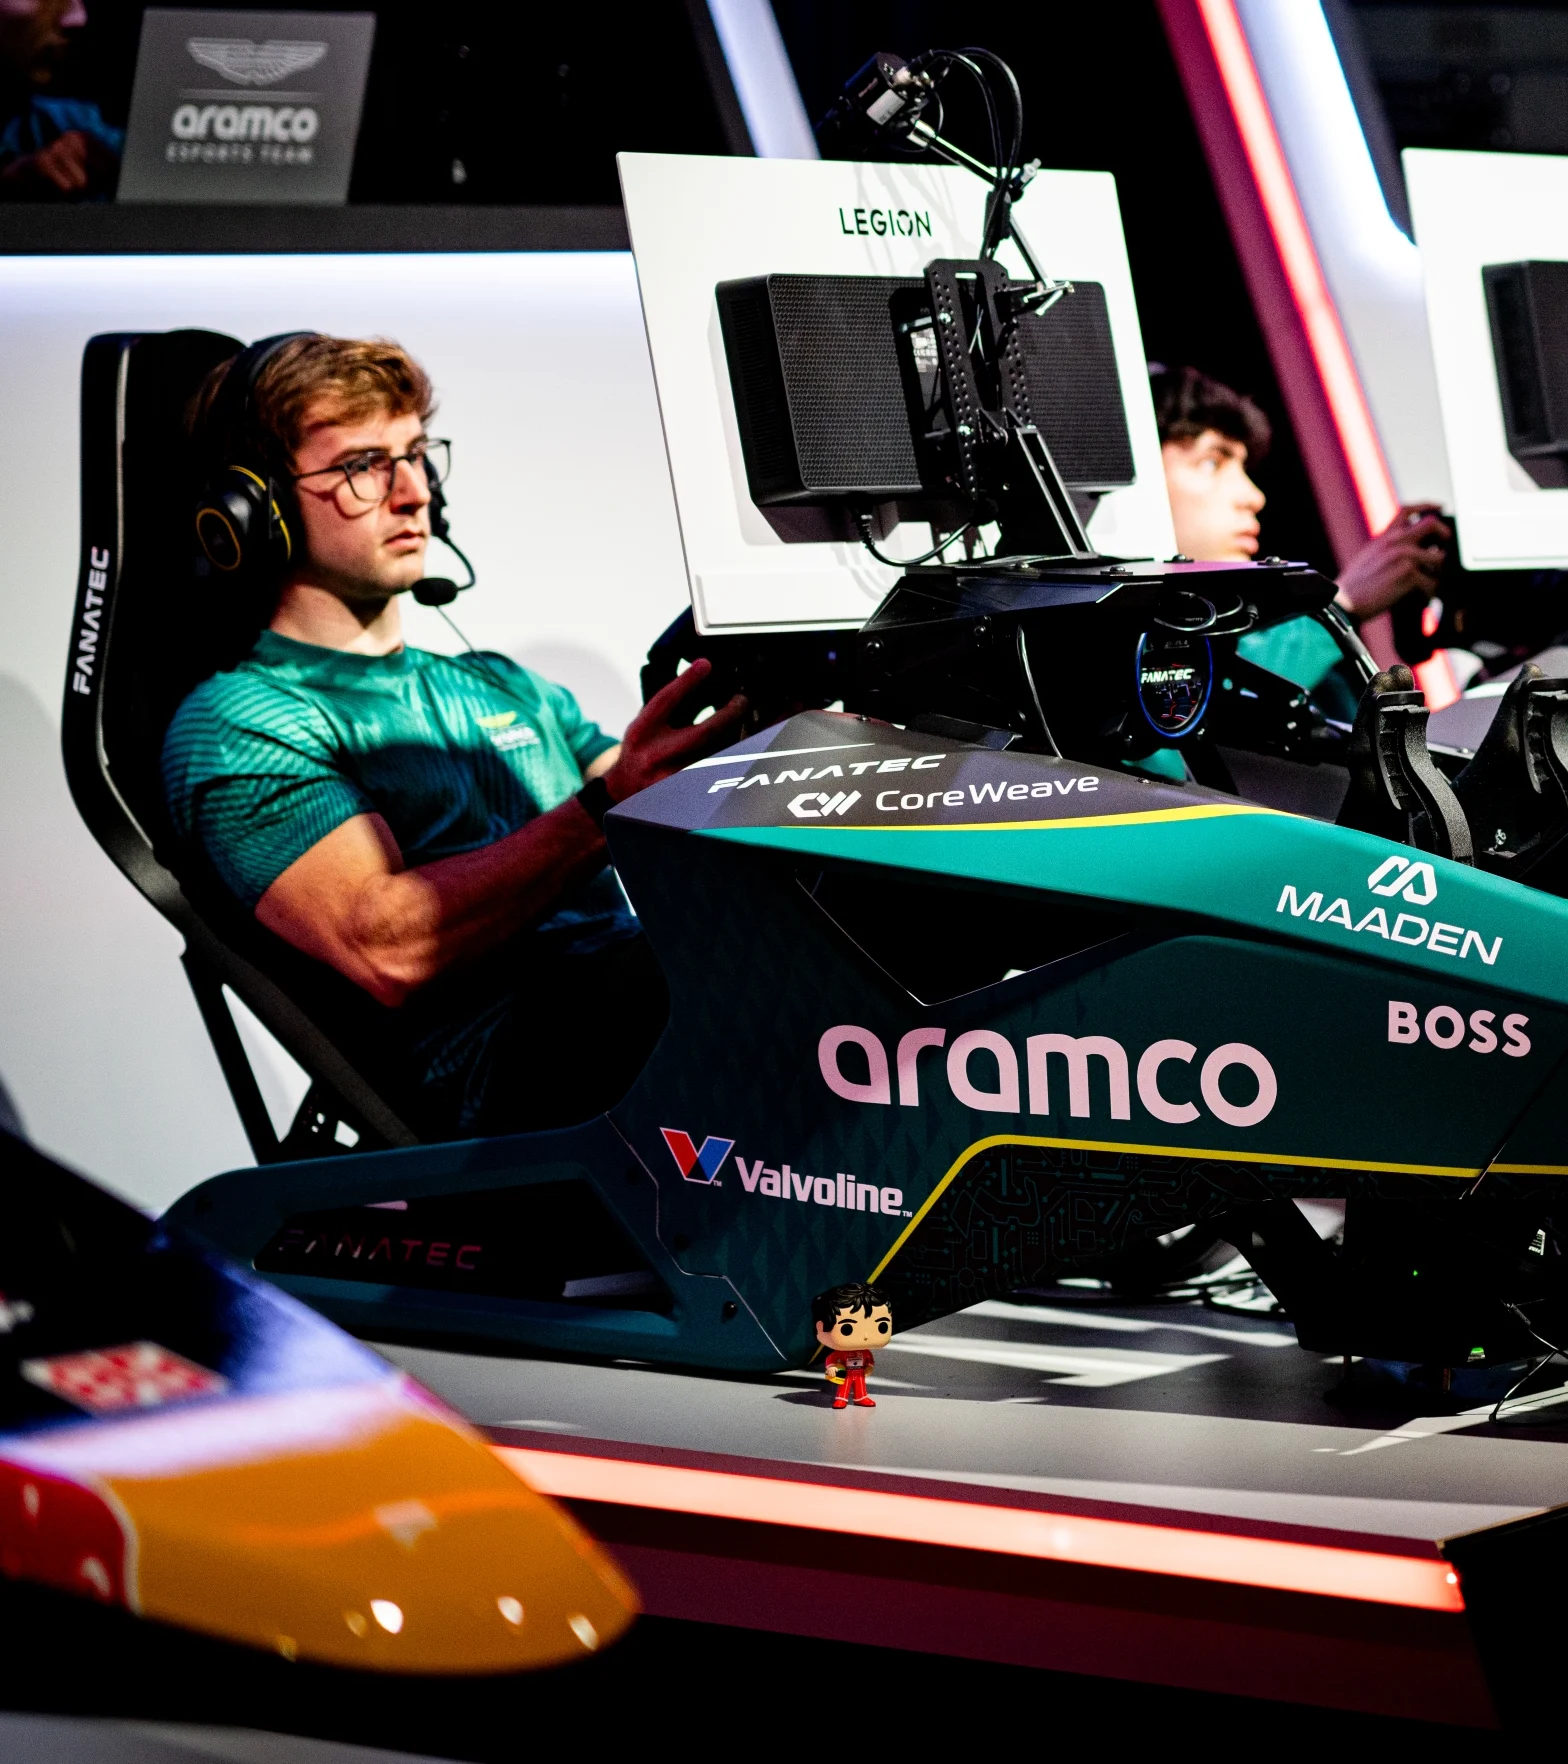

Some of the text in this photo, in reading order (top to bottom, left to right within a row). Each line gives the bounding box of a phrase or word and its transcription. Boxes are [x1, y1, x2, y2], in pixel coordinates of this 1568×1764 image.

[172, 104, 319, 142] aramco
[839, 207, 932, 237] LEGION
[73, 546, 109, 695] FANATEC
[1140, 667, 1196, 684] FANATEC
[707, 753, 946, 794] FANATEC
[876, 776, 1100, 812] CoreWeave
[1276, 884, 1503, 965] MAADEN
[1388, 1000, 1532, 1058] BOSS
[818, 1024, 1278, 1127] aramco
[734, 1156, 904, 1216] Valvoline
[278, 1229, 482, 1270] FANATEC
